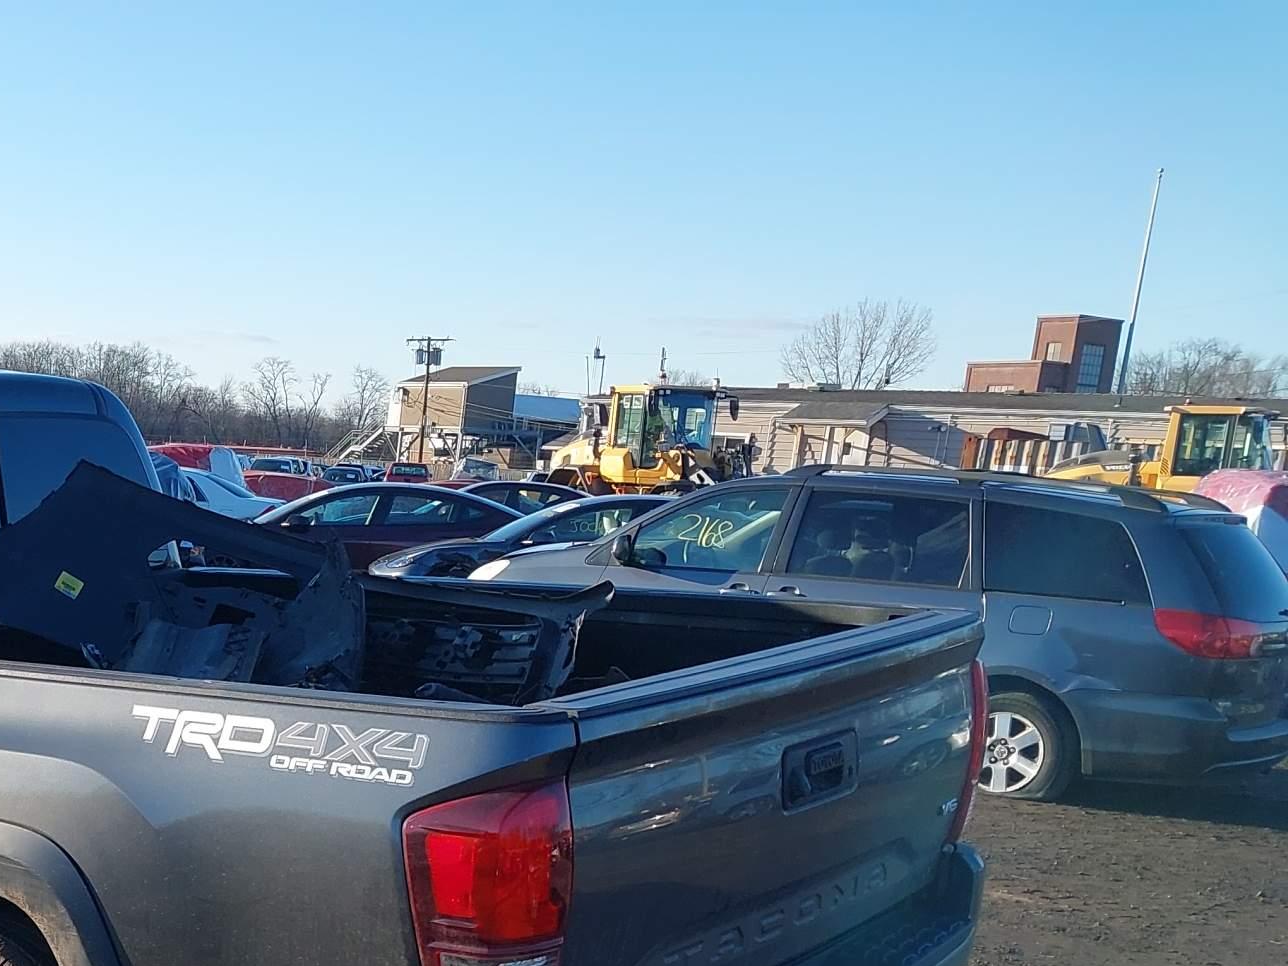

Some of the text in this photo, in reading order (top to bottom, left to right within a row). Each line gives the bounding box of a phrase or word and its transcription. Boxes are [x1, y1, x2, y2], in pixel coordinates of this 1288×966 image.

[677, 513, 734, 549] 2168
[132, 704, 430, 769] TRD 4X4
[270, 754, 414, 787] OFF ROAD
